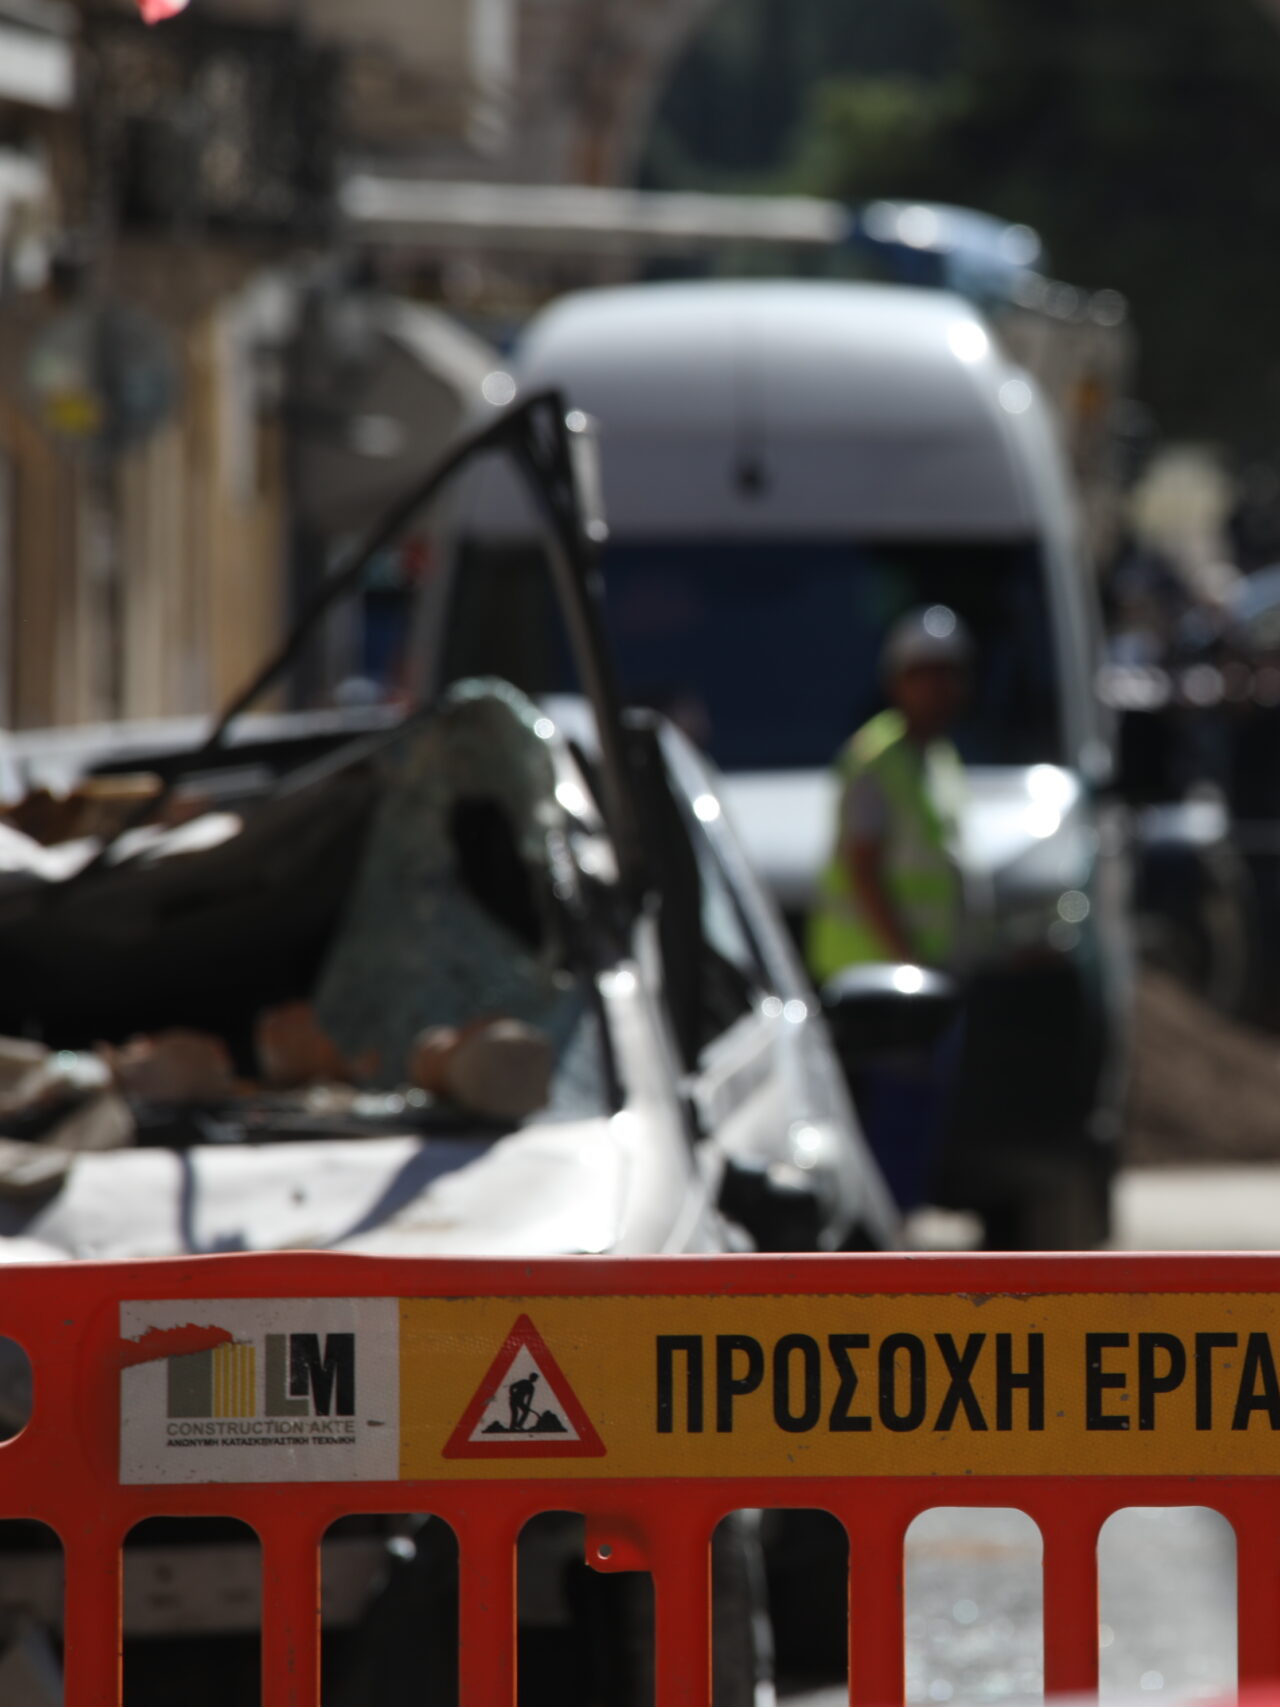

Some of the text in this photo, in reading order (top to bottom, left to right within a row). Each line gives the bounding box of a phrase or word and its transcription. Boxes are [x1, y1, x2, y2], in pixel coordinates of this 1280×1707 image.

[655, 1332, 1045, 1433] ΠΡΟΣΟΧΗ
[166, 1420, 355, 1436] CONSTRUCTION AKTE
